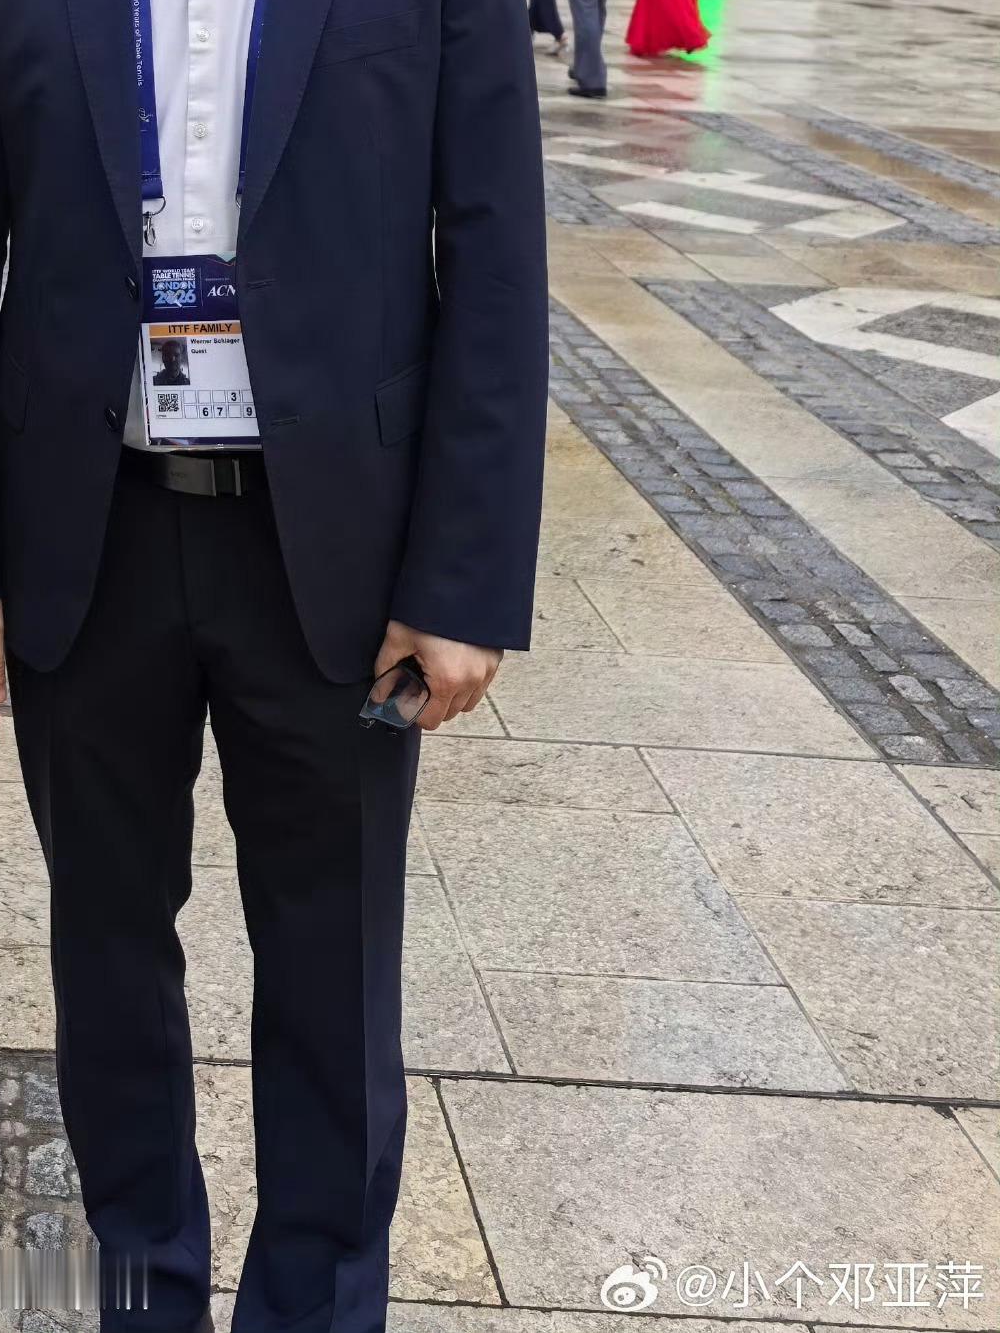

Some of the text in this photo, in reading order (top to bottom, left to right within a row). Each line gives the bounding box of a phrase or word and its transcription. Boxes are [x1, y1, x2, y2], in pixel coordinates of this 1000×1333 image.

[133, 7, 141, 27] Years
[135, 38, 143, 59] Table
[136, 60, 144, 87] Tennis
[152, 280, 196, 291] LONDON
[168, 323, 233, 333] ITTF FAMILY
[230, 392, 237, 402] 3
[202, 406, 253, 417] 6 7 9
